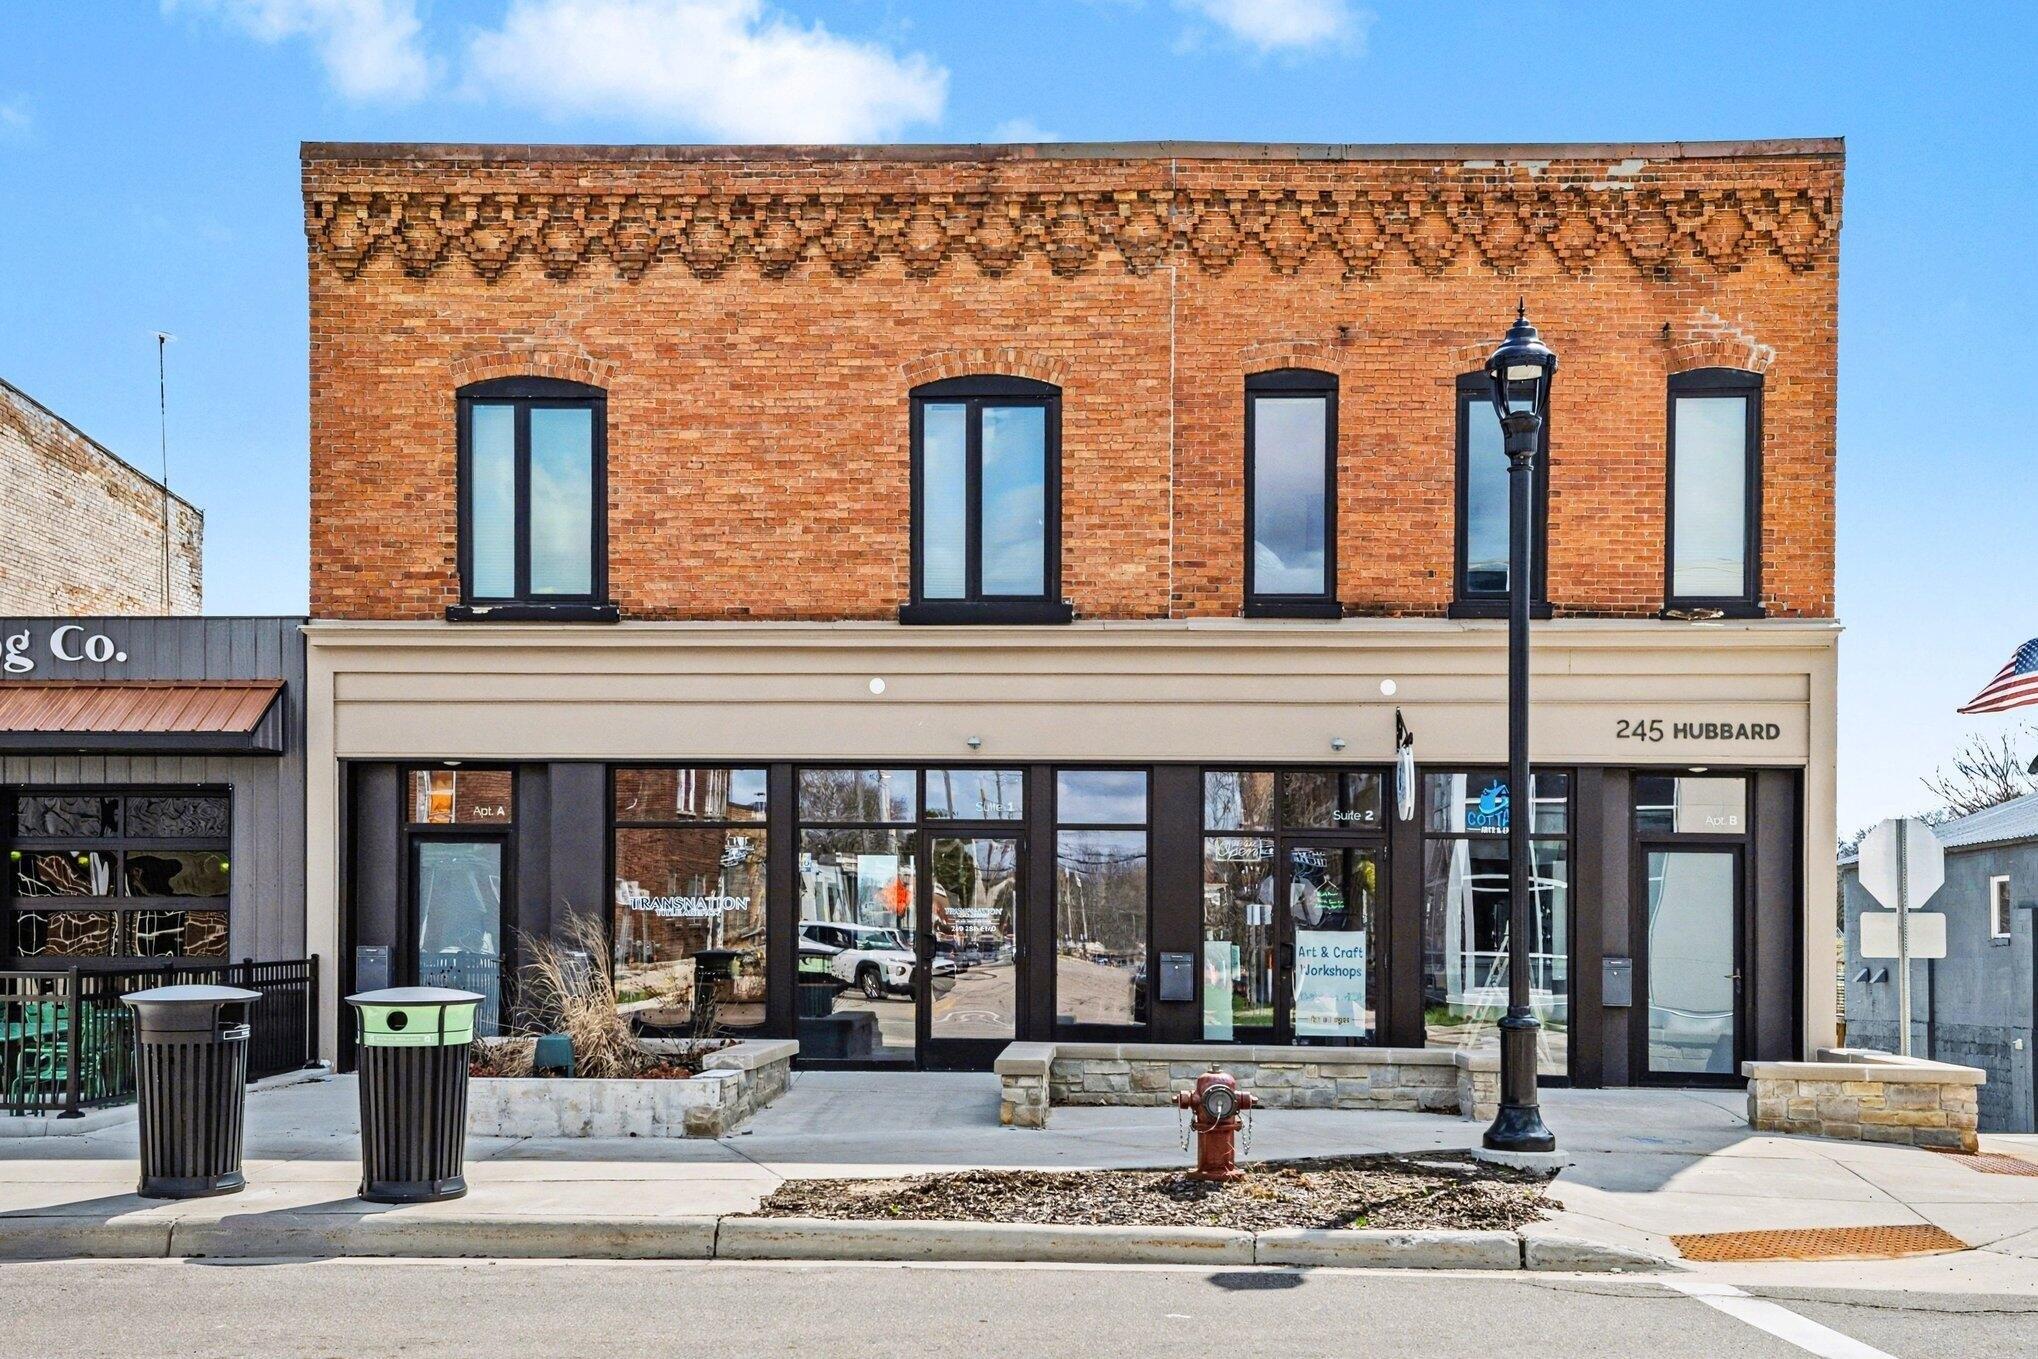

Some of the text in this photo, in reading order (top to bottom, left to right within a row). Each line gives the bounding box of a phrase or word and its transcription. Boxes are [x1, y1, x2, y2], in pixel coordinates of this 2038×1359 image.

[0, 625, 128, 673] g Co.
[1616, 719, 1781, 742] 245 HUBBARD
[496, 806, 505, 816] A
[975, 801, 1015, 812] Suite 1
[1333, 810, 1374, 821] Suite 2
[1467, 808, 1510, 827] COTTA
[1729, 815, 1738, 826] B
[629, 896, 751, 911] TRANSNATION
[1299, 946, 1363, 958] Art & Craft
